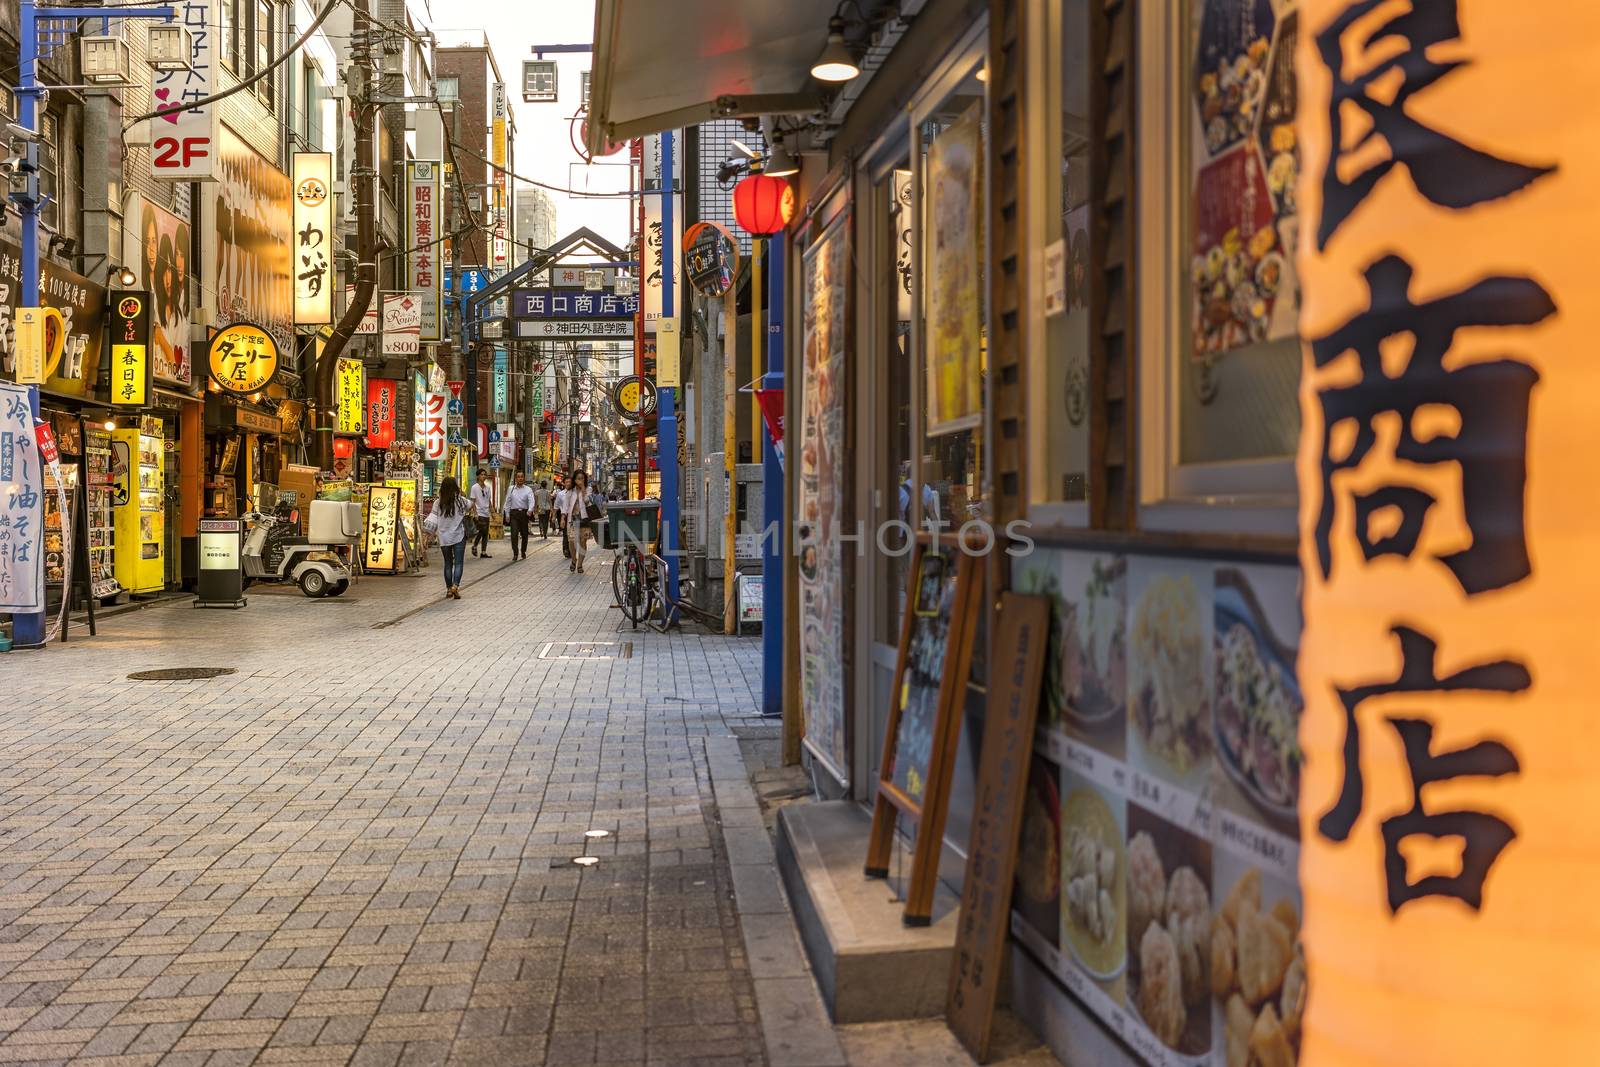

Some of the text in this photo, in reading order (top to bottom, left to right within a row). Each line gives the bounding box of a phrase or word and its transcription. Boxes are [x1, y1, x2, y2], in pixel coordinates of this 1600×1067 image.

[154, 137, 210, 168] 2F
[415, 186, 431, 288] 昭和薬品本店
[298, 222, 327, 298] わいず
[122, 301, 138, 341] 油そば
[526, 293, 640, 314] 西口商店街
[556, 323, 627, 334] 神田外語学院
[216, 340, 272, 363] ターリー
[231, 362, 247, 381] 屋
[122, 349, 138, 400] 春日亭
[216, 372, 236, 389] CURRY
[248, 376, 266, 389] NAAN
[427, 394, 445, 459] クスリ
[6, 394, 38, 563] 冷やし油そば
[371, 522, 384, 563] わいず
